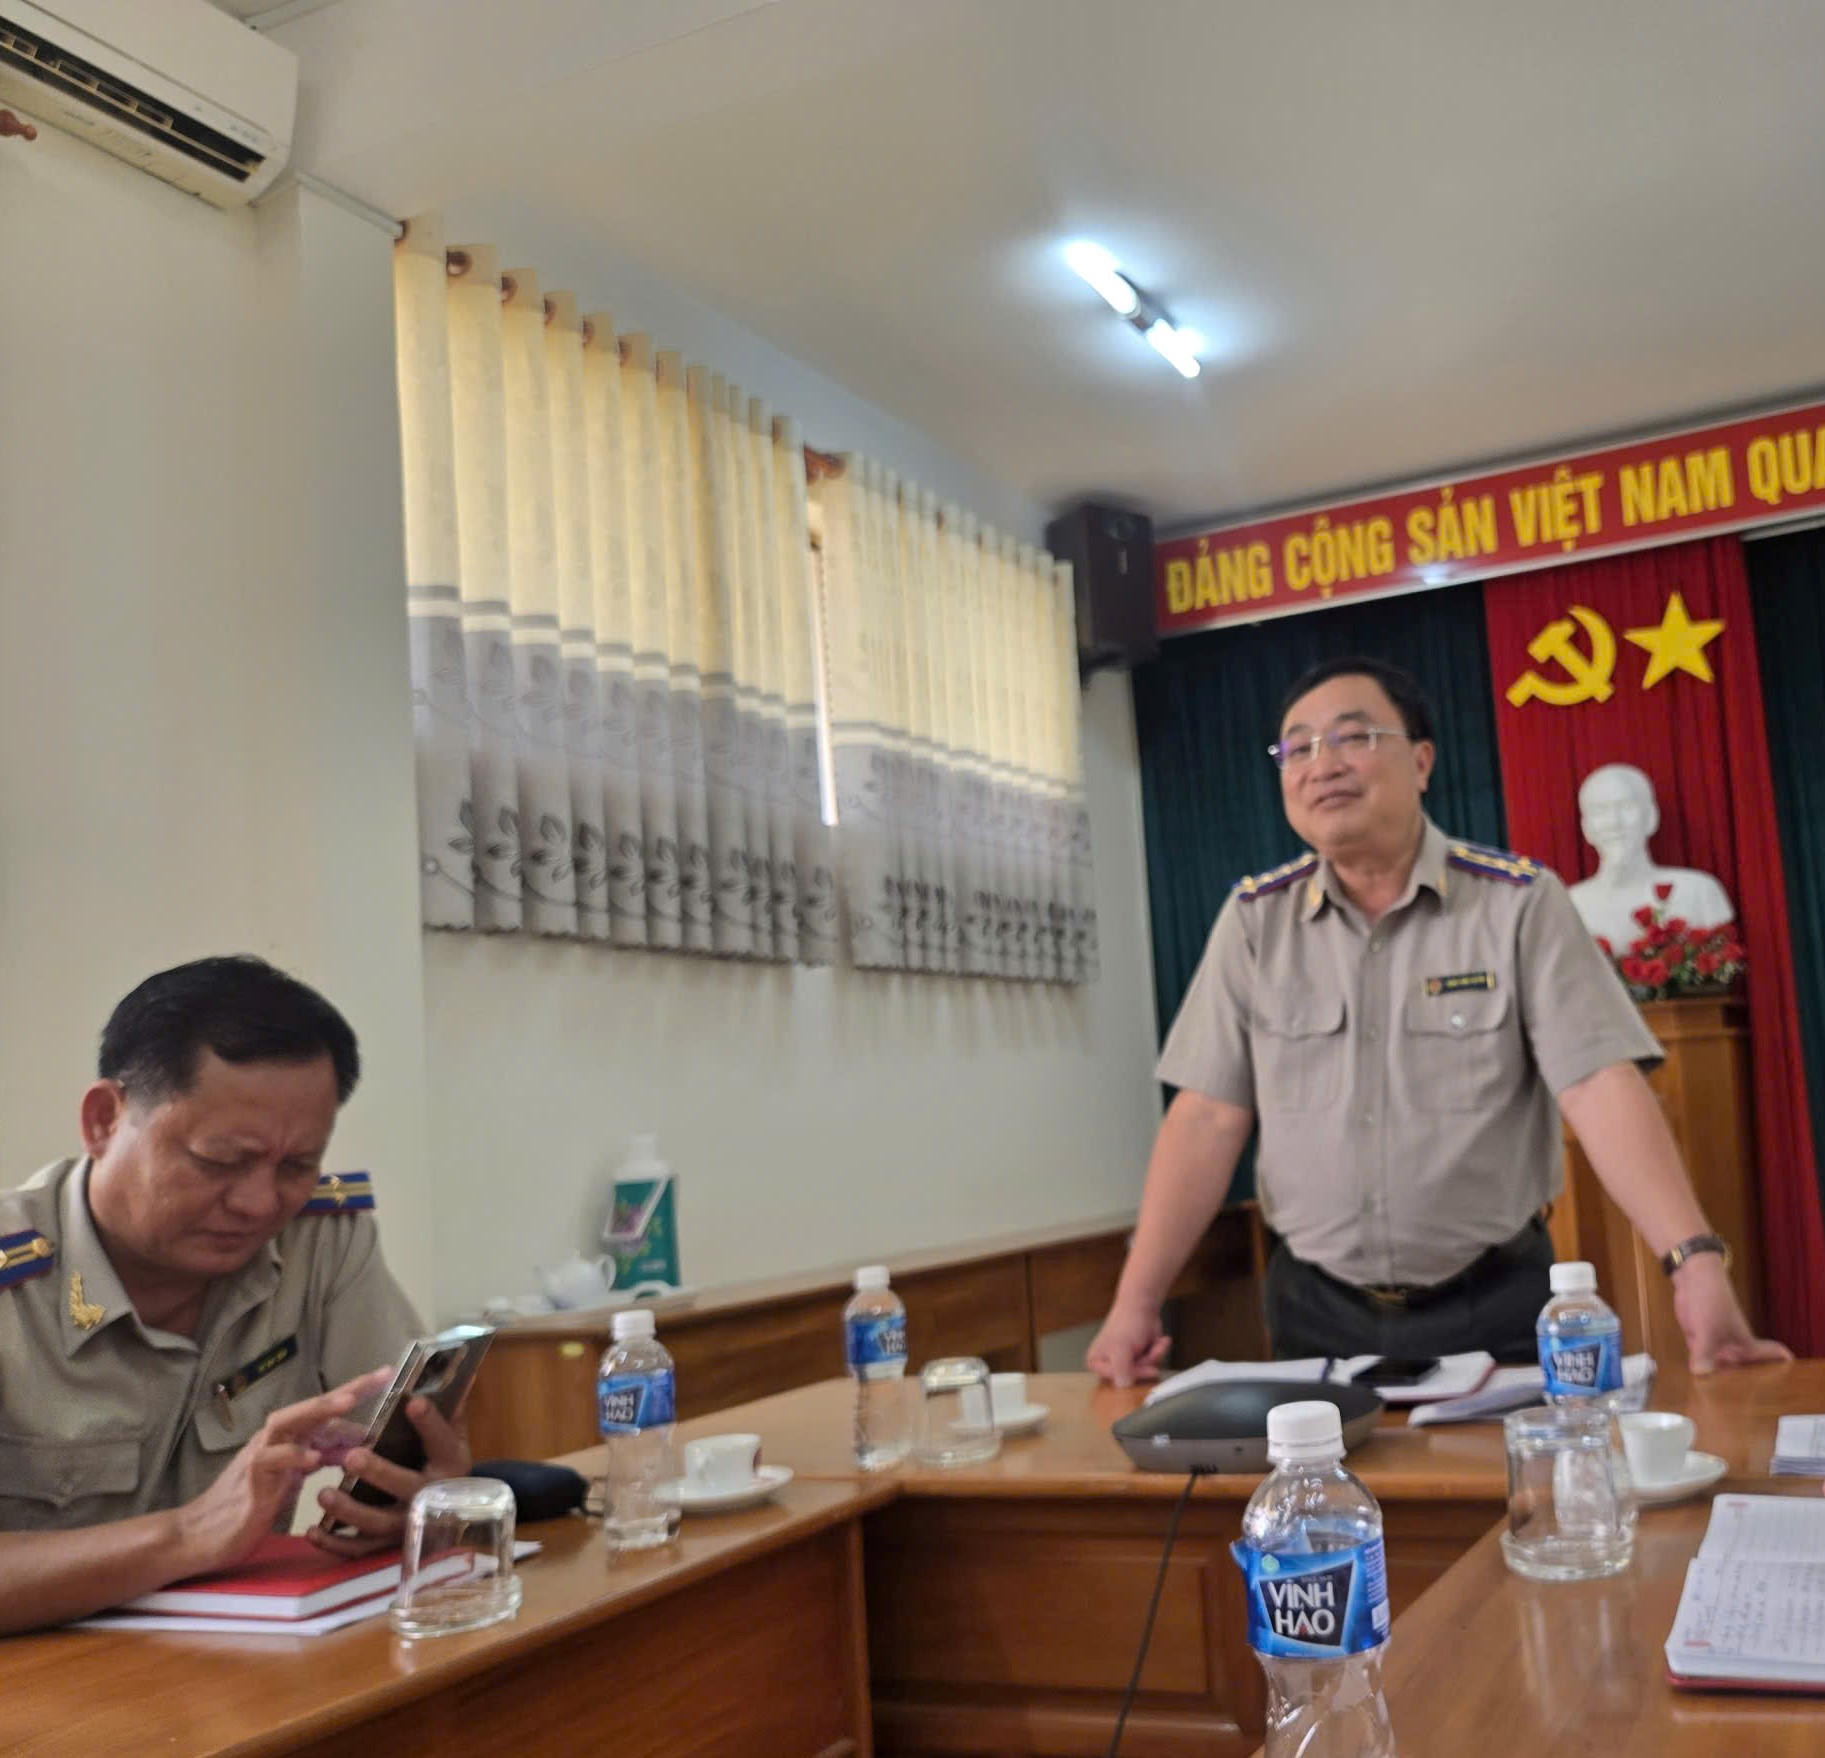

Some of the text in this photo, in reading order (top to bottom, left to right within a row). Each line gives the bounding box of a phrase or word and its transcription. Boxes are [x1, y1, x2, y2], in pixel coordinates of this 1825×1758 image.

[1166, 539, 1275, 614] ĐẢNG
[1283, 514, 1396, 597] CỘNG
[1406, 485, 1500, 566] SẢN
[1509, 466, 1605, 552] VIỆT
[1621, 447, 1735, 526] NAM
